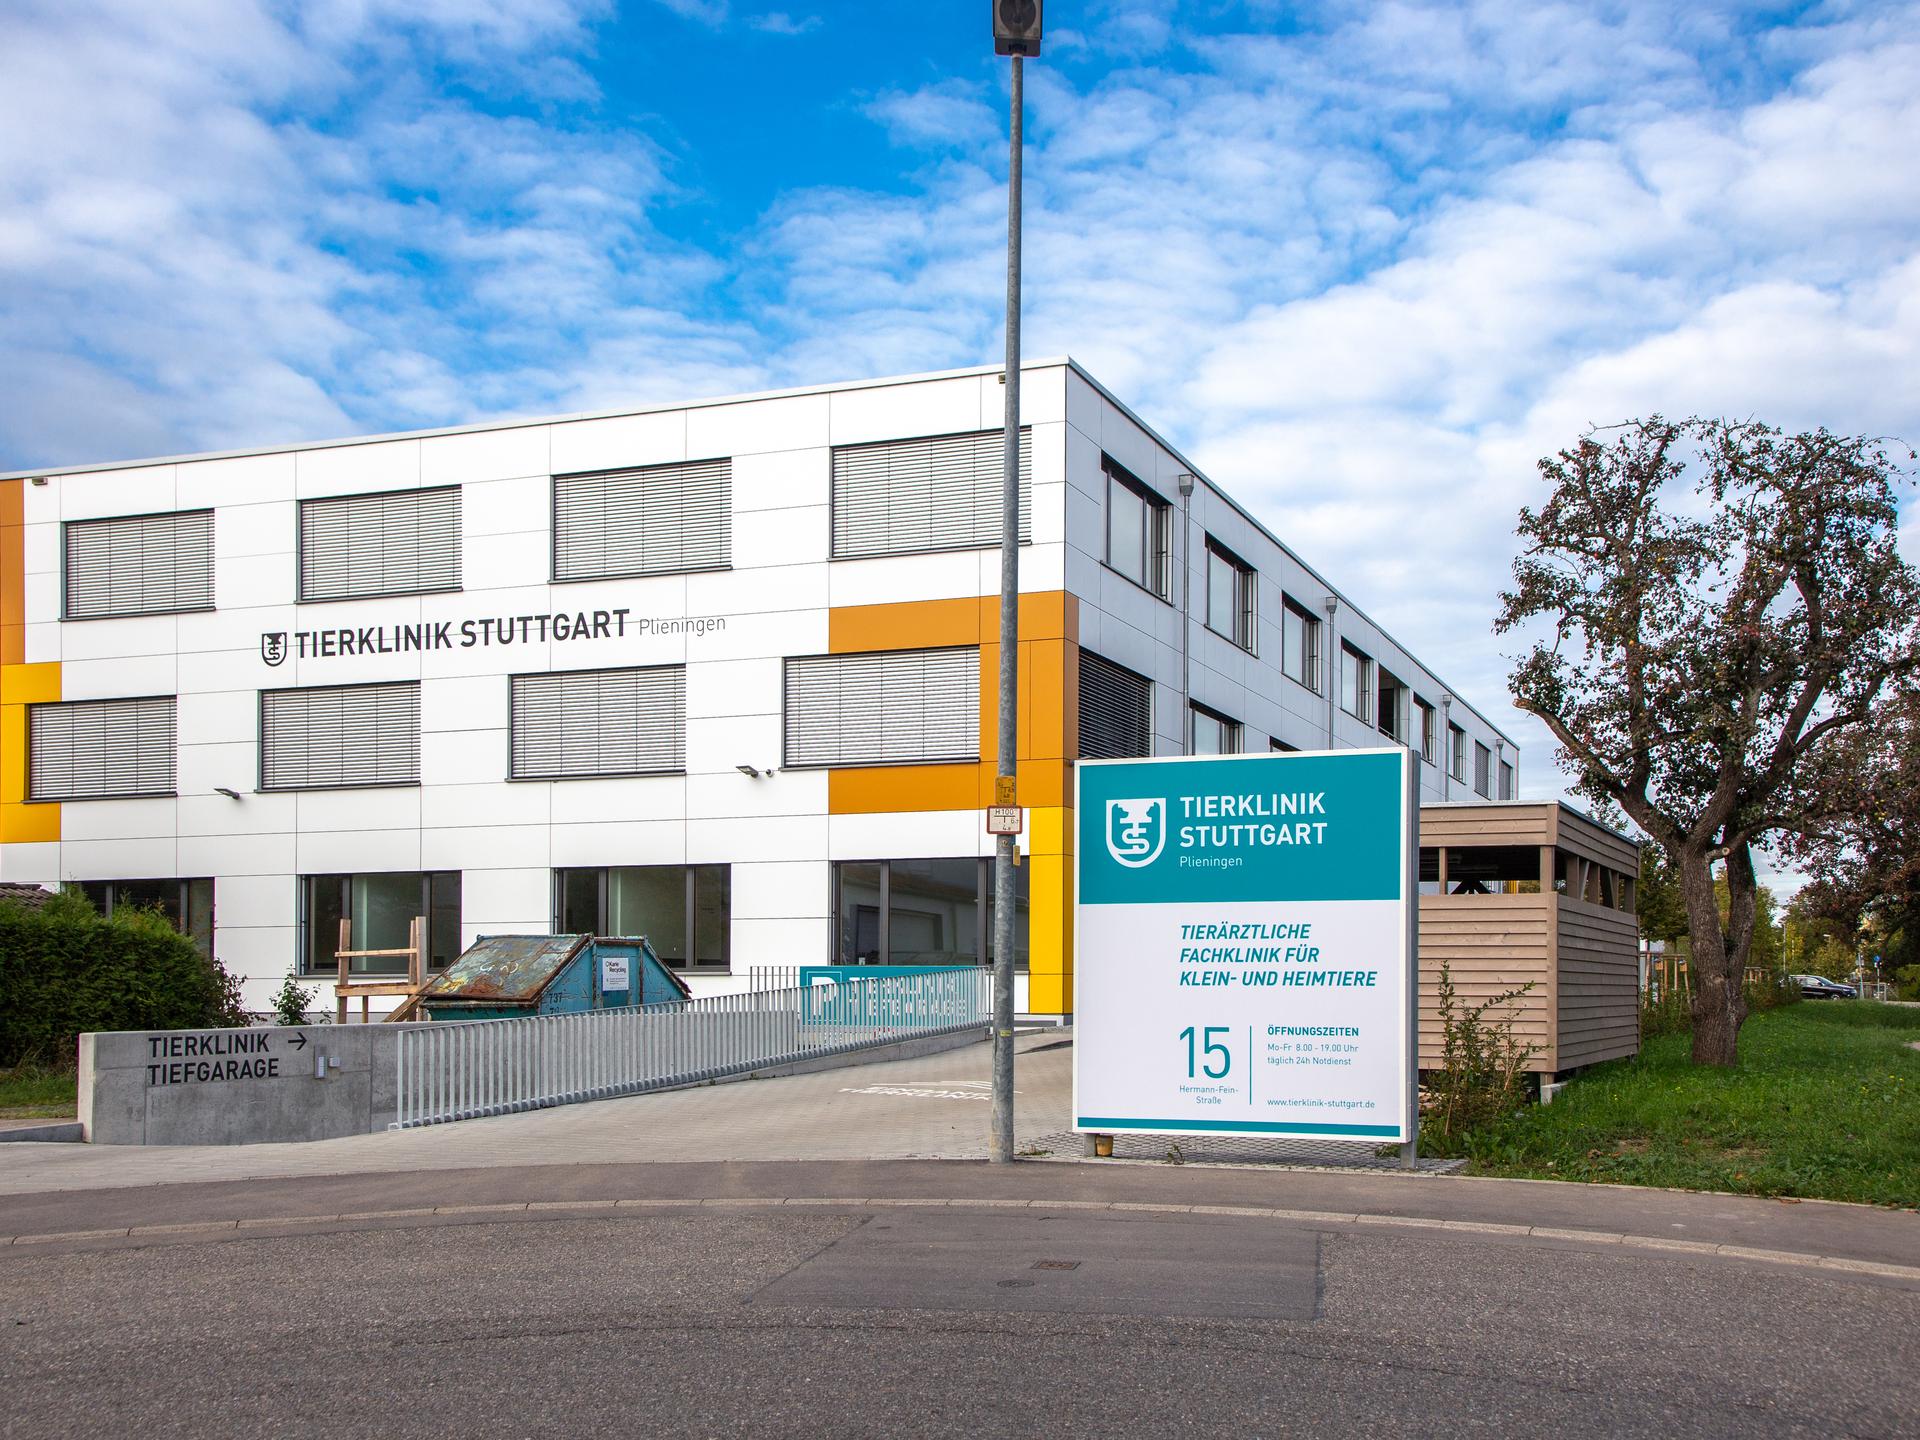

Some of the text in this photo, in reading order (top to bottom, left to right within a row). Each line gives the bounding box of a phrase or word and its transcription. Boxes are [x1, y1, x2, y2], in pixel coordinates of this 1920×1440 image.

[294, 608, 727, 659] TIERKLINIK STUTTGART Plieningen
[1179, 792, 1326, 818] TIERKLINIK
[1179, 822, 1328, 848] STUTTGART
[1180, 855, 1243, 870] Plieningen
[1180, 920, 1311, 940] TIERÄRZTLICHE
[1179, 943, 1320, 963] FACHKLINIK FÜR
[1179, 970, 1378, 987] KLEIN- UND HEIMTIERE
[1267, 1024, 1359, 1037] ÖFFNUNGSZEITEN
[148, 1033, 270, 1058] TIERKLINIK
[1179, 1026, 1231, 1079] 15
[1267, 1043, 1292, 1052] Mo-Fr
[1295, 1043, 1313, 1052] 8.00
[1320, 1043, 1342, 1053] 19.00
[1343, 1043, 1359, 1053] Uhr
[1267, 1056, 1352, 1066] täglich 24h Notdienst
[147, 1057, 280, 1085] TIEFGARAGE
[1179, 1084, 1239, 1094] Hermann-Fein-
[1196, 1096, 1222, 1105] Straße
[1267, 1098, 1375, 1110] www.tierklinik-stuttgart.de
